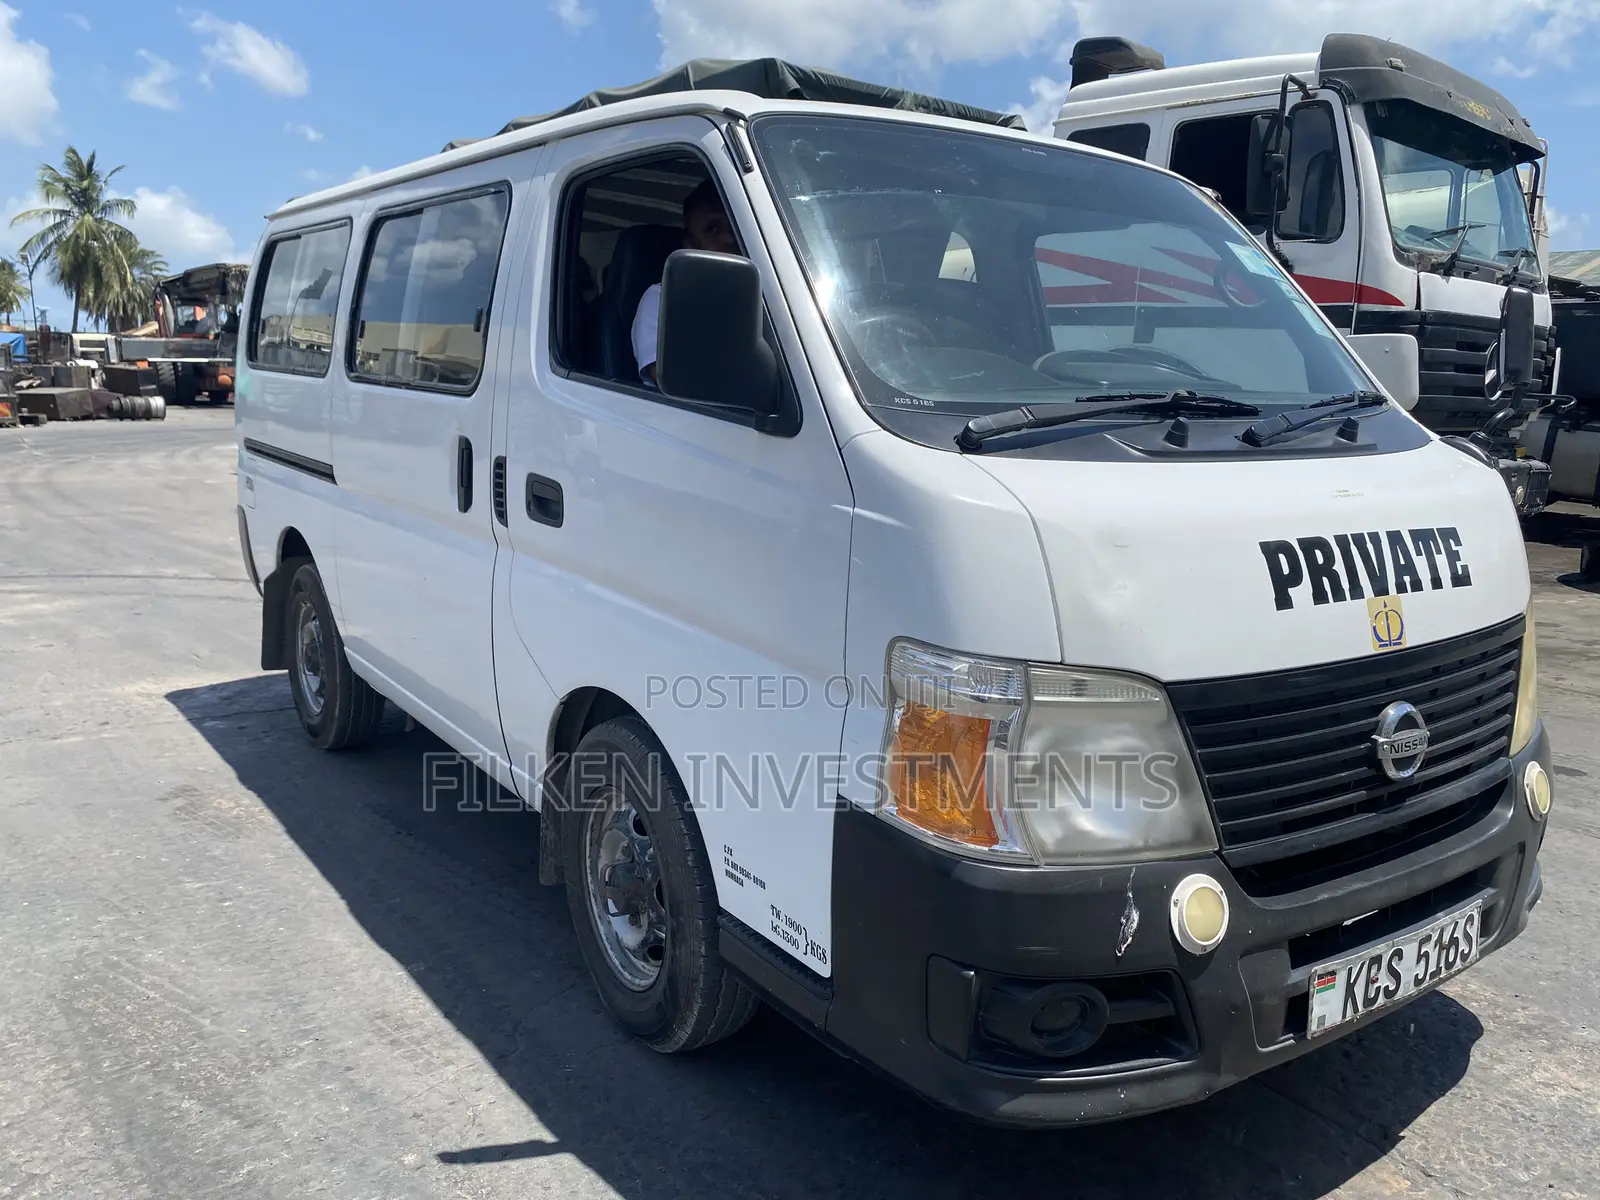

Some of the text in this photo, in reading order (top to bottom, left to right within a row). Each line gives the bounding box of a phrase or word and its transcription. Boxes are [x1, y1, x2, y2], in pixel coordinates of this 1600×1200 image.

[1258, 526, 1472, 611] PRIVATE
[1342, 913, 1474, 1020] KCS 516S
